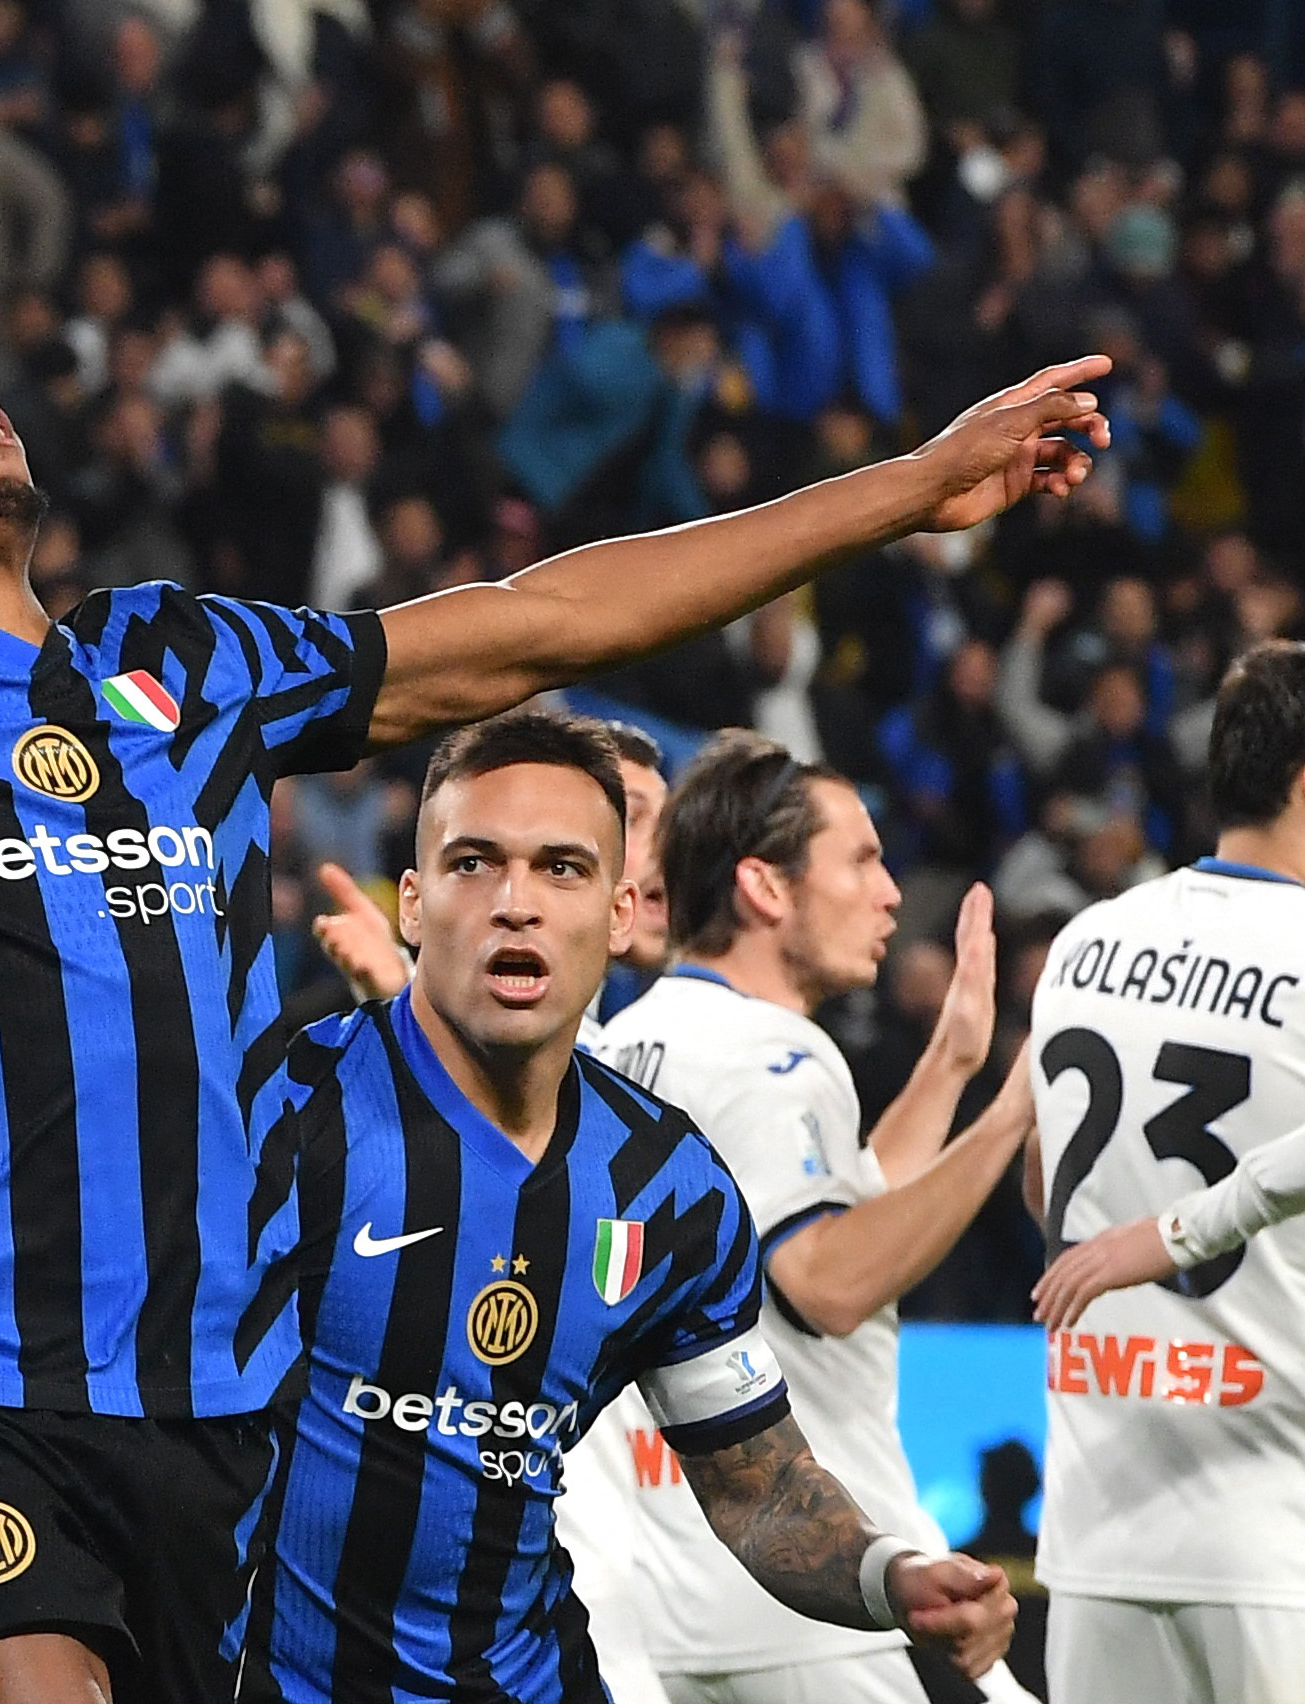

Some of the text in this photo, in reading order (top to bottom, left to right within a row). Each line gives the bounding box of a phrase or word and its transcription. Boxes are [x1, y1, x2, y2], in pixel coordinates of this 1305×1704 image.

[98, 876, 225, 925] .sport
[1040, 1027, 1252, 1299] 23
[342, 1376, 579, 1438] betsson
